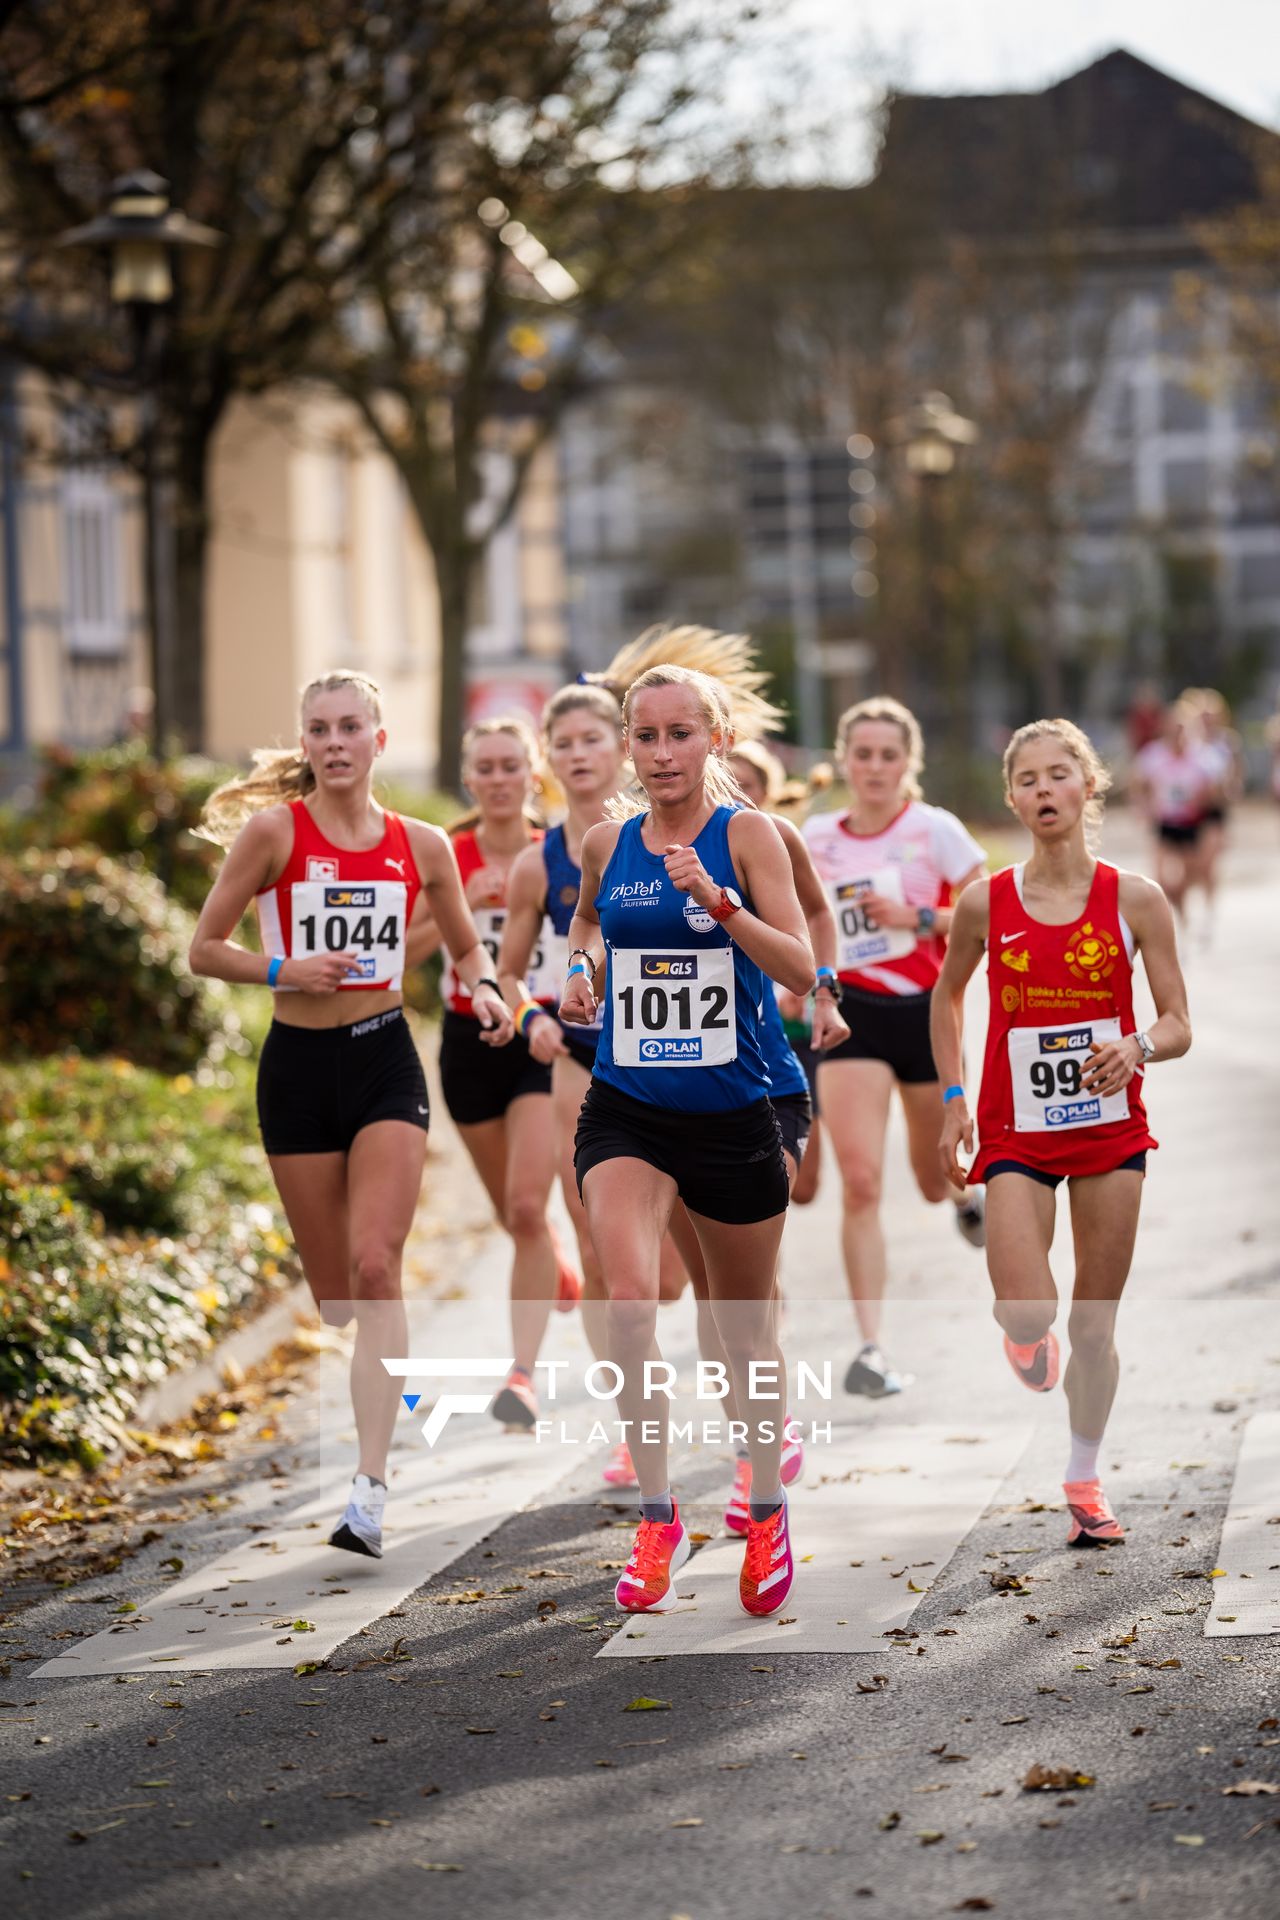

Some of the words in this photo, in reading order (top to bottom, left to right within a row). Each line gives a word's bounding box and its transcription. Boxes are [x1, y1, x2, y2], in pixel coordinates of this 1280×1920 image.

[350, 891, 373, 906] GLS
[299, 915, 399, 951] 1044
[669, 961, 693, 976] GLS
[1056, 988, 1064, 998] &
[618, 986, 729, 1030] 1012
[664, 1042, 699, 1053] PLAN
[1067, 1033, 1090, 1048] GLS
[1067, 1102, 1098, 1116] PLAN
